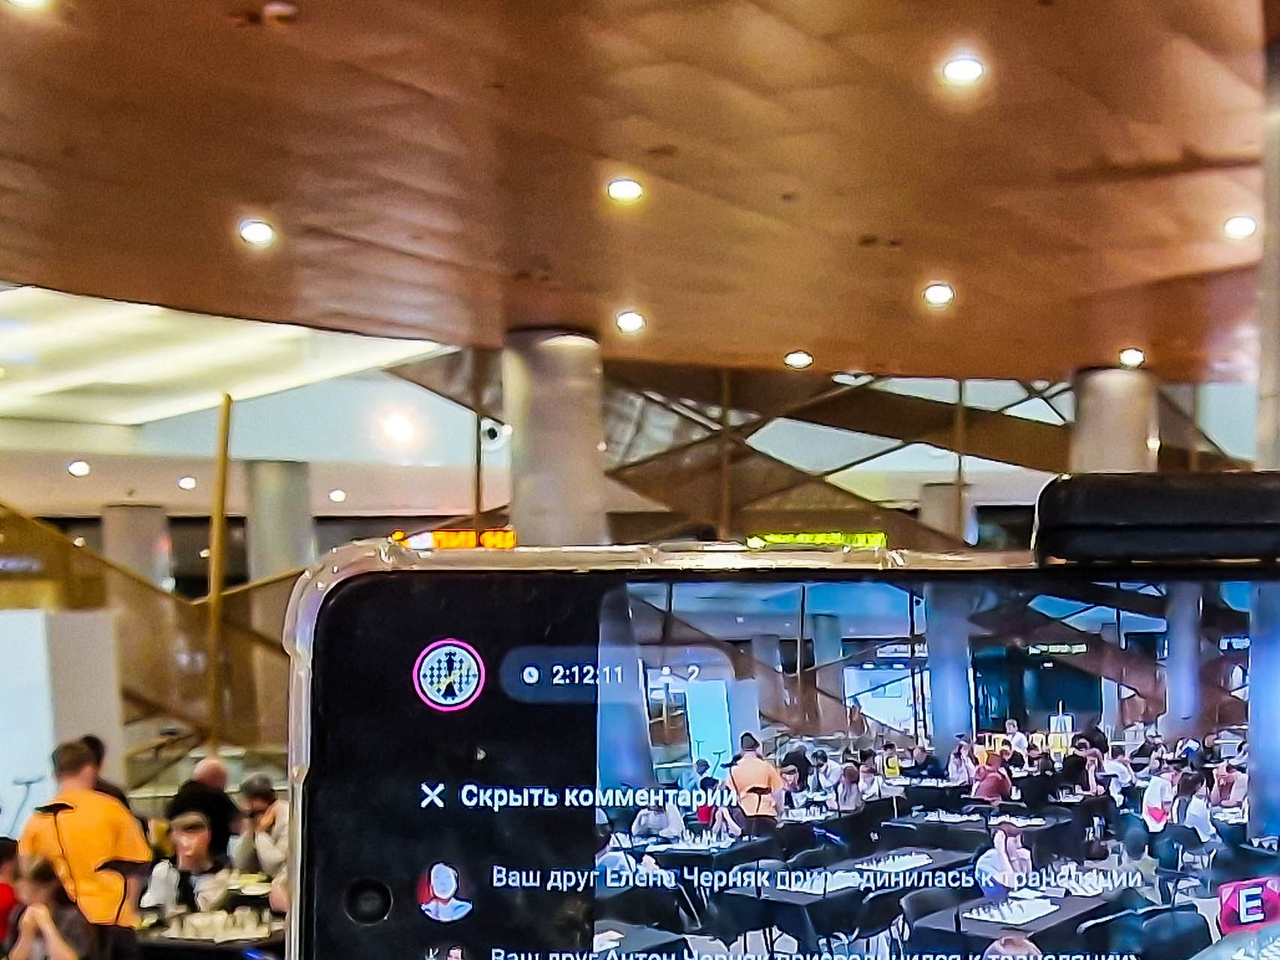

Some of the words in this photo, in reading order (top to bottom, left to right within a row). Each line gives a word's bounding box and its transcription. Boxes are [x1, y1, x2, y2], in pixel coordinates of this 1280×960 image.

[552, 664, 623, 685] 2:12:11
[687, 664, 701, 682] 2
[461, 785, 557, 812] Скрыть
[566, 788, 738, 812] комментарии
[492, 866, 539, 888] Ваш
[547, 871, 599, 893] друг
[683, 866, 770, 893] Черняк
[776, 870, 975, 893] придинилась
[981, 875, 995, 888] к
[1237, 886, 1265, 924] E
